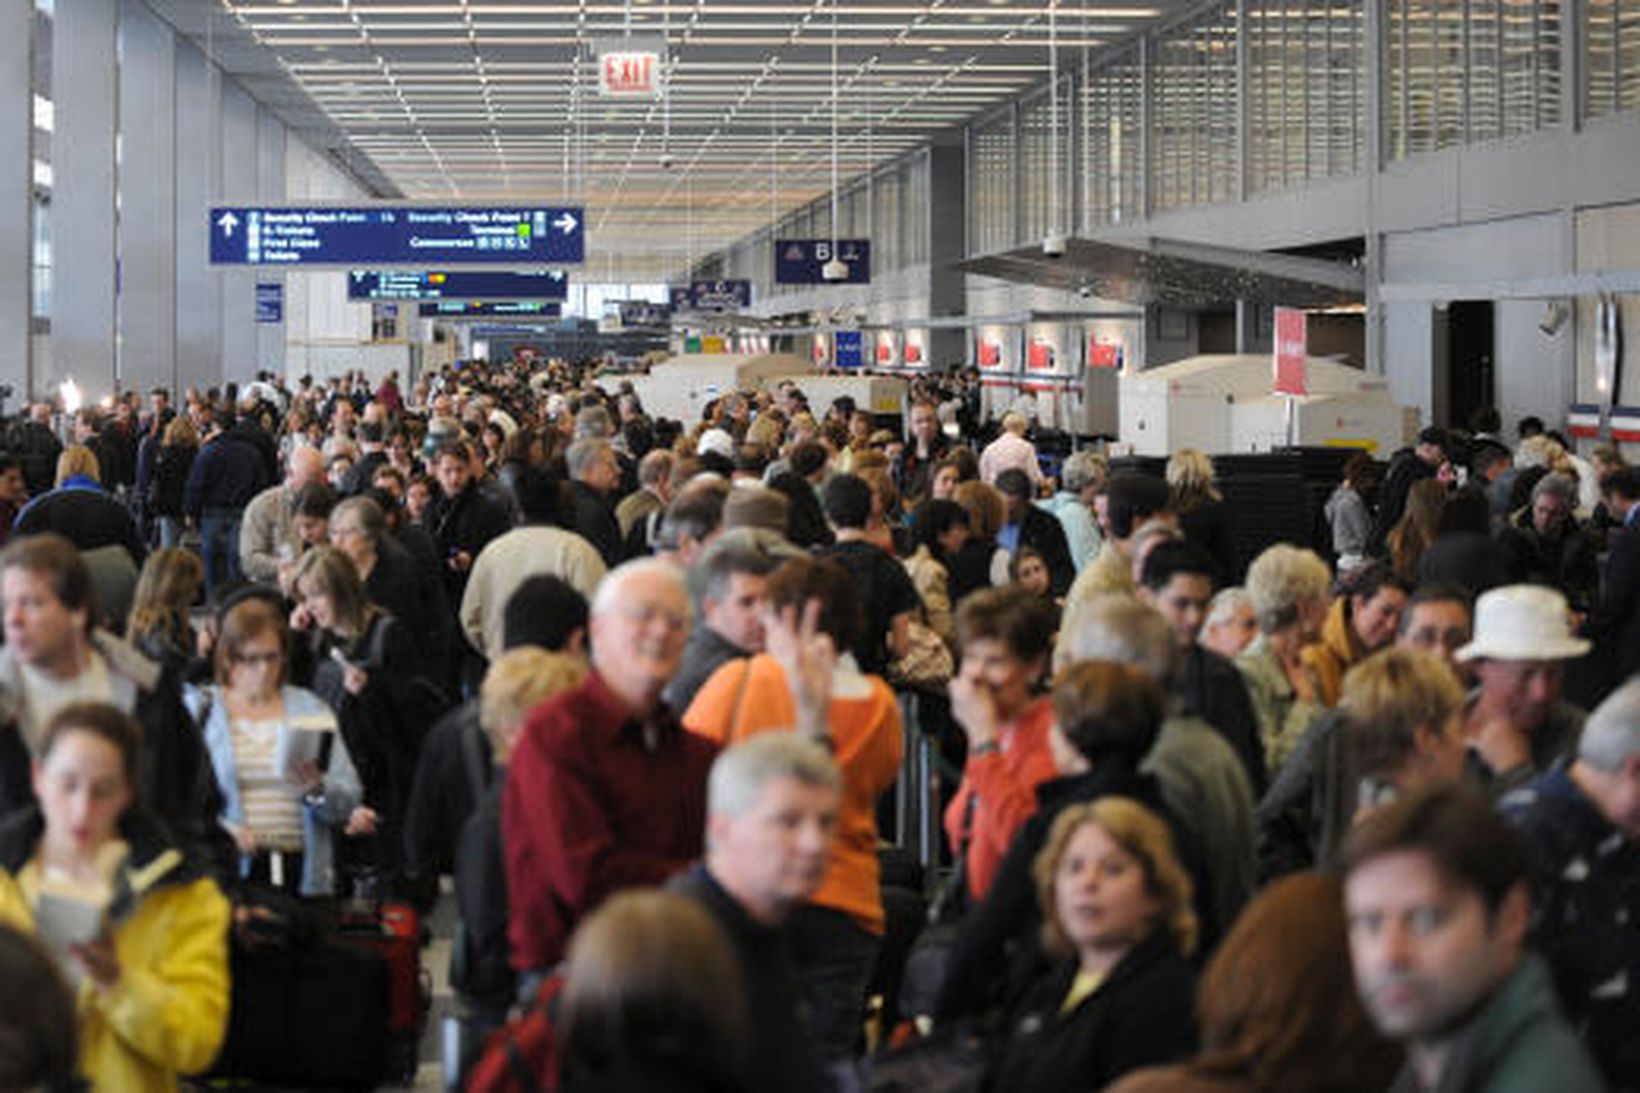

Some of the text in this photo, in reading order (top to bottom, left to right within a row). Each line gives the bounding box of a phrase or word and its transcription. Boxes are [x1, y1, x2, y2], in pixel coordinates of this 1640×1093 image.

[605, 55, 657, 84] EXIT
[454, 211, 489, 222] Check
[815, 243, 830, 260] B
